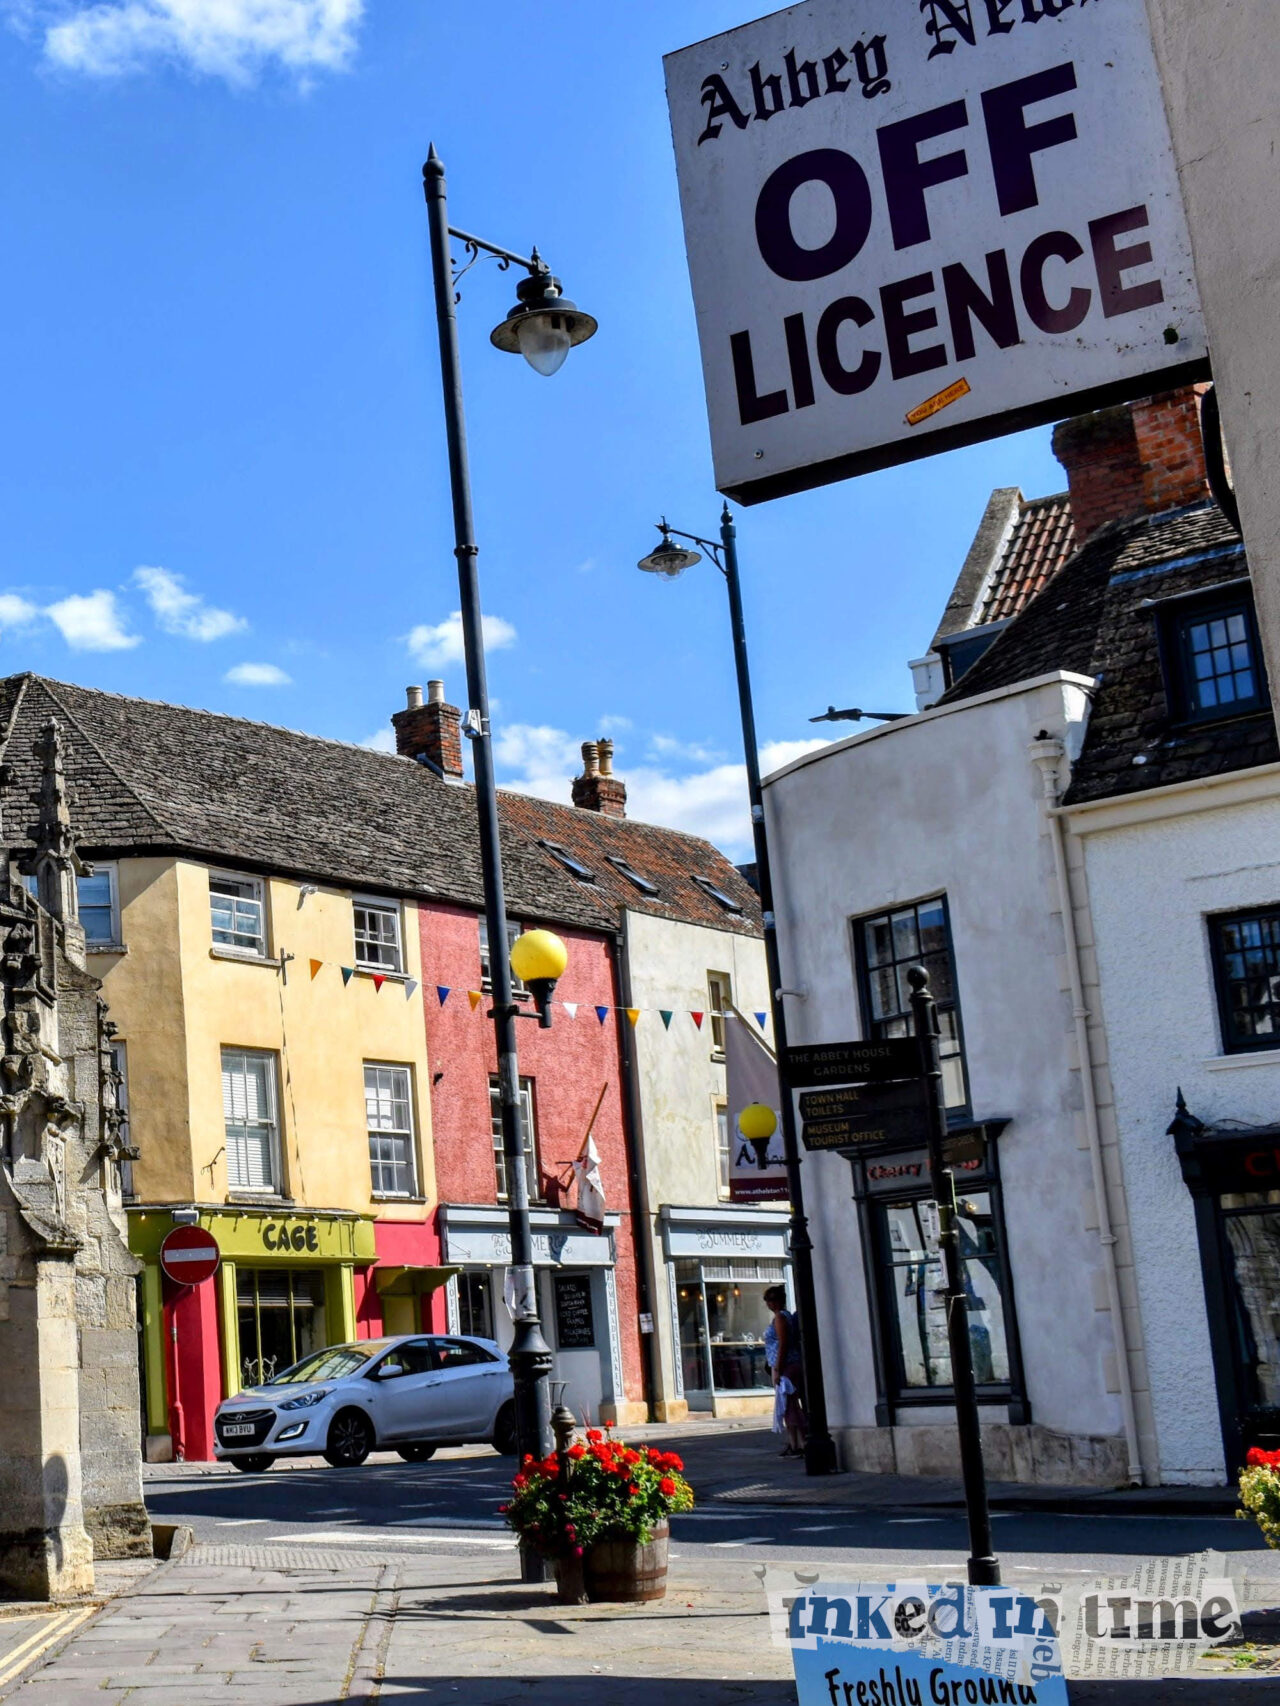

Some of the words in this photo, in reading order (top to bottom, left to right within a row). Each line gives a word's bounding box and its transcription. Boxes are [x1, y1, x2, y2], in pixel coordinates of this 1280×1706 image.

[698, 33, 890, 146] Abbey
[754, 61, 1078, 282] OFF
[730, 204, 1164, 425] LICENCE
[788, 1053, 809, 1064] THE
[813, 1050, 850, 1061] ABBEY
[852, 1047, 893, 1058] HOUSE
[814, 1063, 871, 1077] GARDENS
[805, 1095, 834, 1106] TOWN
[835, 1090, 859, 1102] HALL
[806, 1104, 845, 1117] TOILETS
[807, 1122, 849, 1135] MUSEUM
[808, 1133, 850, 1147] TOURIST
[851, 1130, 886, 1142] OFFICE
[262, 1223, 319, 1252] CAGE
[706, 1228, 749, 1248] SUMMER
[824, 1664, 924, 1706] Freshly
